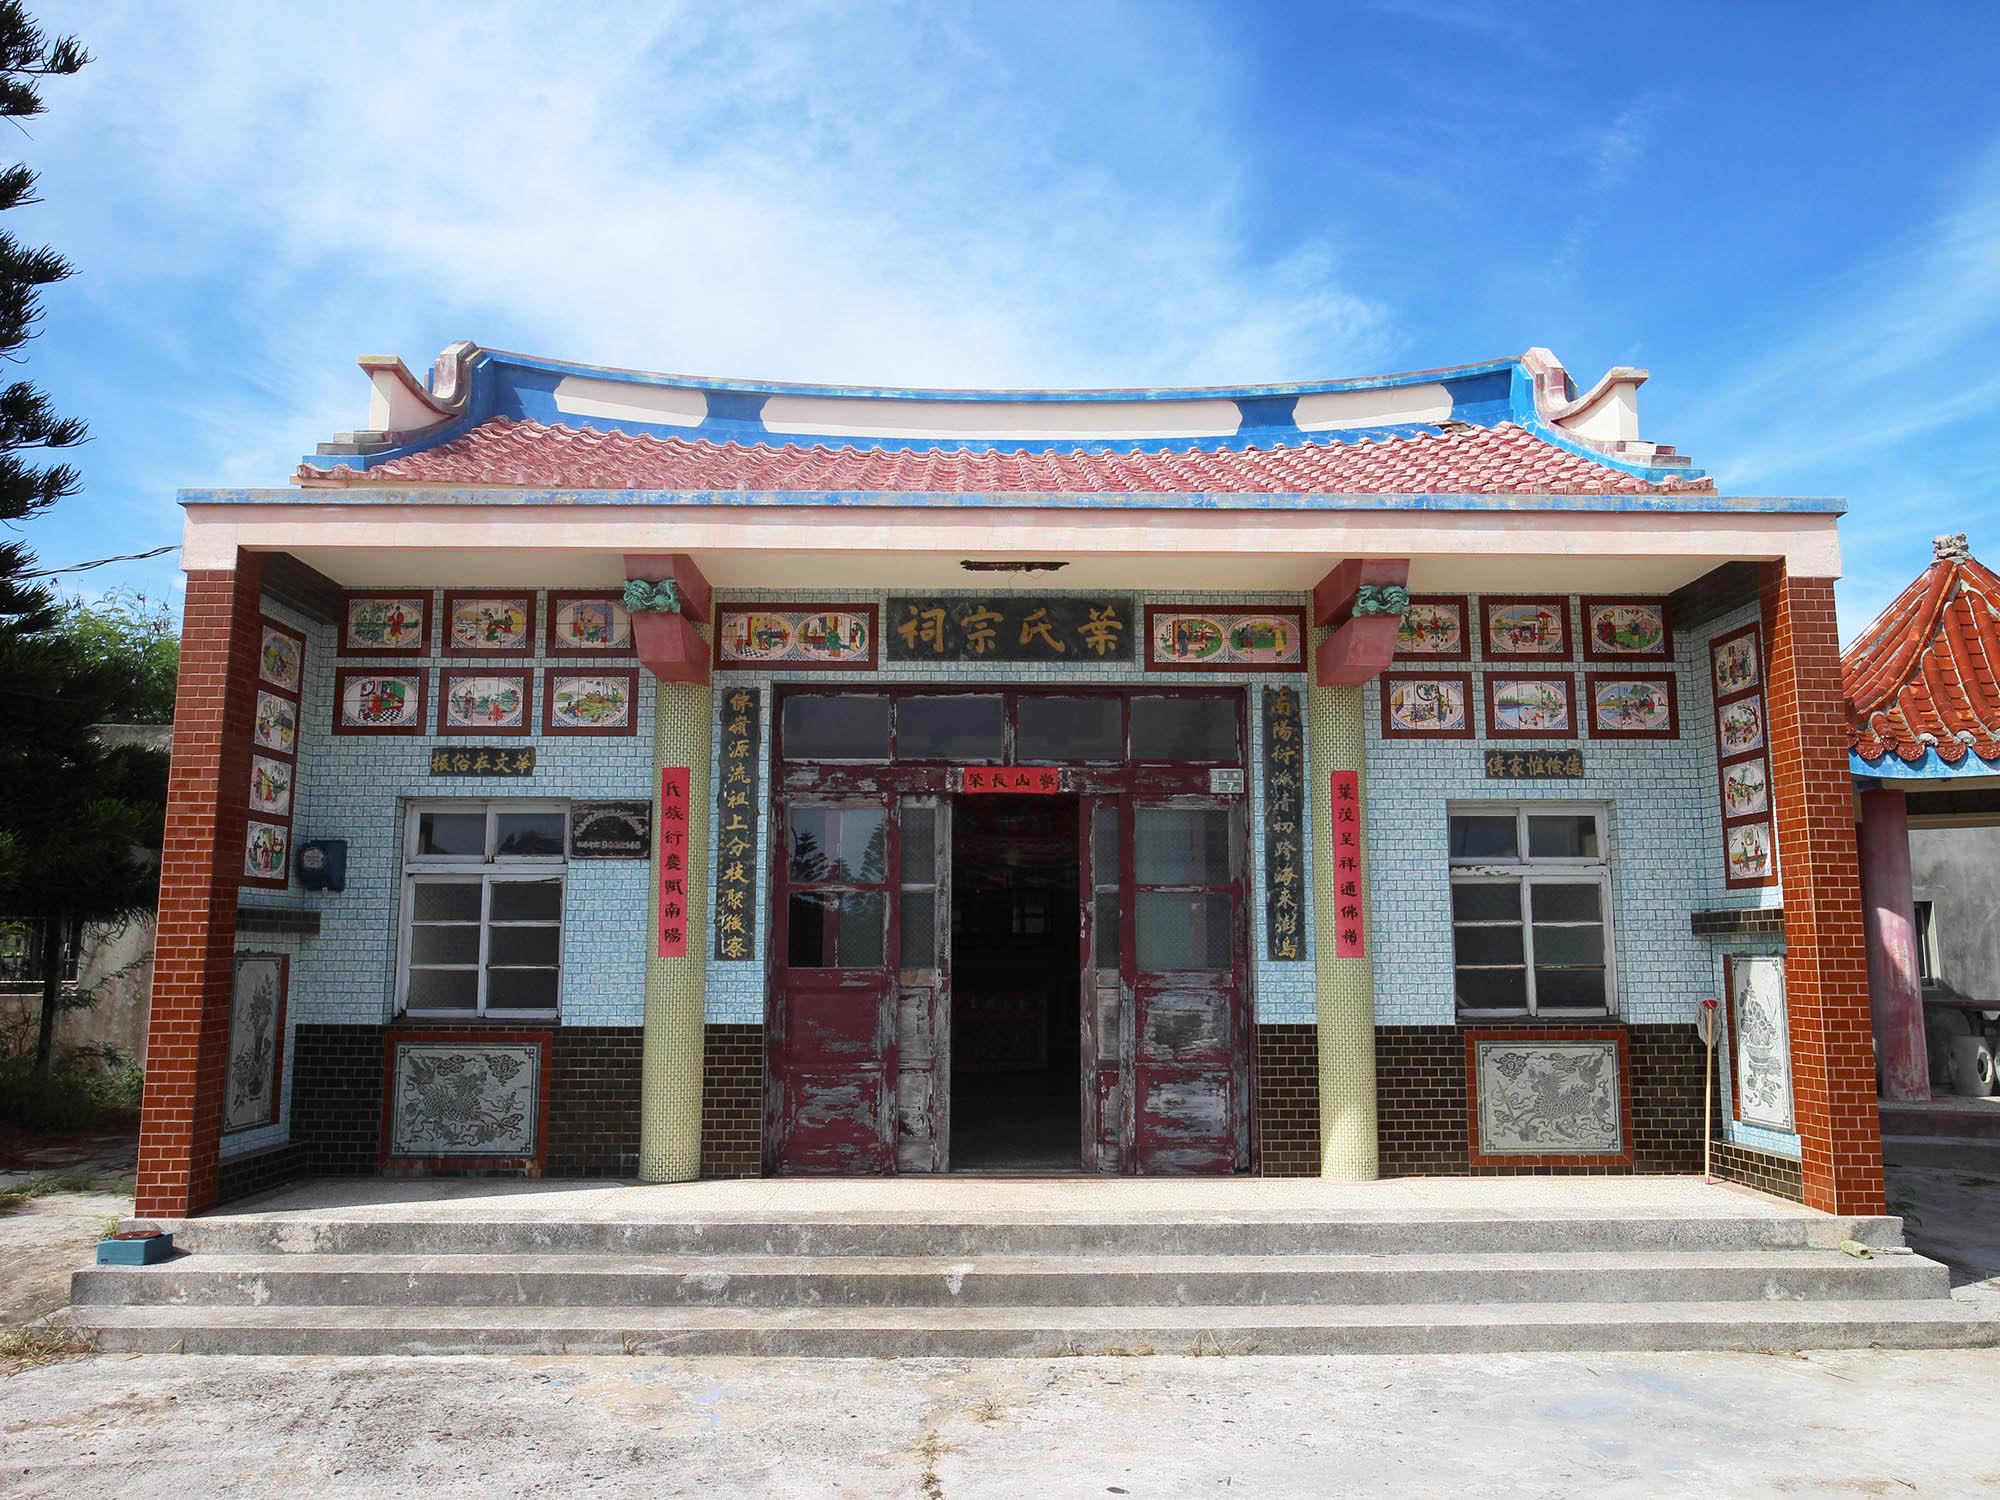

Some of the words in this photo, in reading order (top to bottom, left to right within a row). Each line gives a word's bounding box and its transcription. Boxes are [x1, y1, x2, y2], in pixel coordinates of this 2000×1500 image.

[897, 605, 1123, 656] 葉氏宗祠
[1227, 782, 1234, 791] 7
